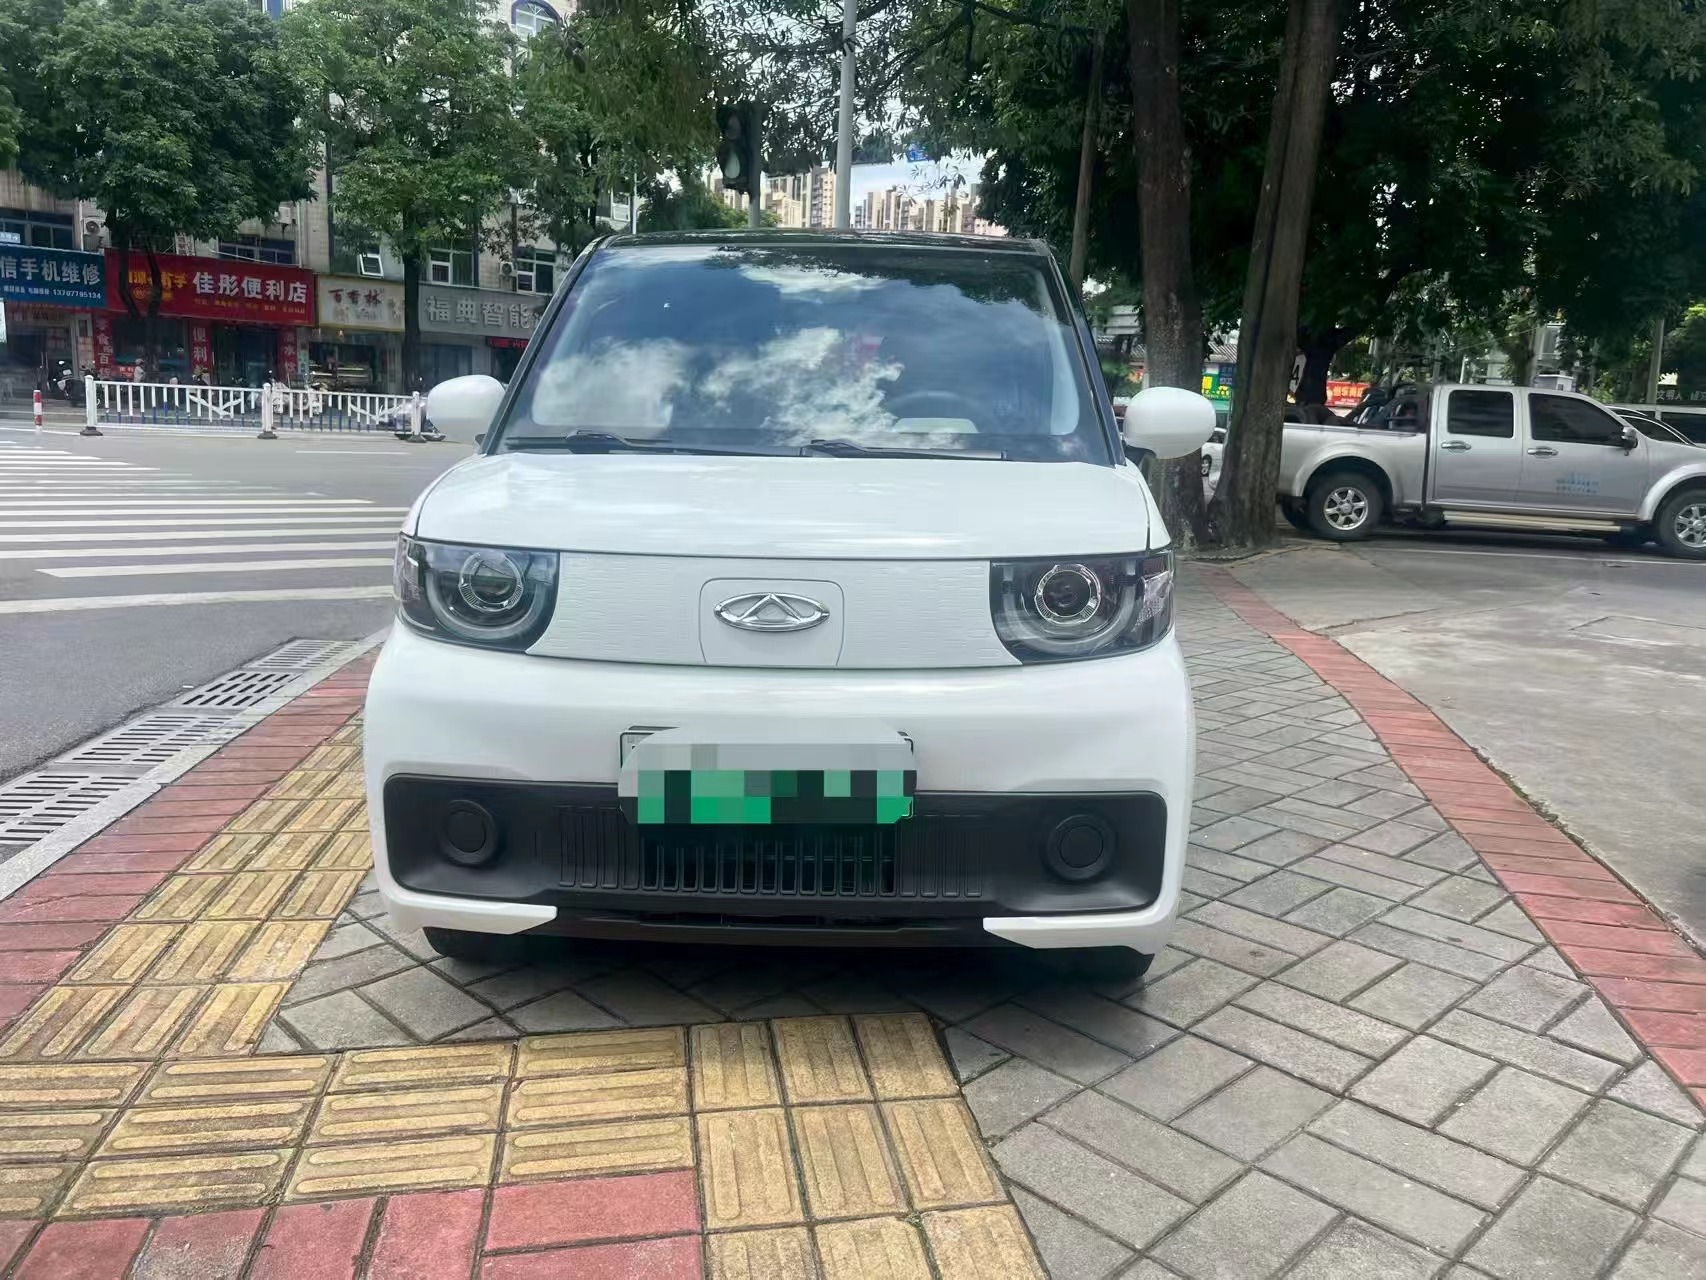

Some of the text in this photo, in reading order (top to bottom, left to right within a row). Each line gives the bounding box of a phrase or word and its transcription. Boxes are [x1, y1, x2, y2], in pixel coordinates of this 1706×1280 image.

[0, 256, 100, 285] 信手机维修
[193, 272, 307, 304] 佳彤便利店
